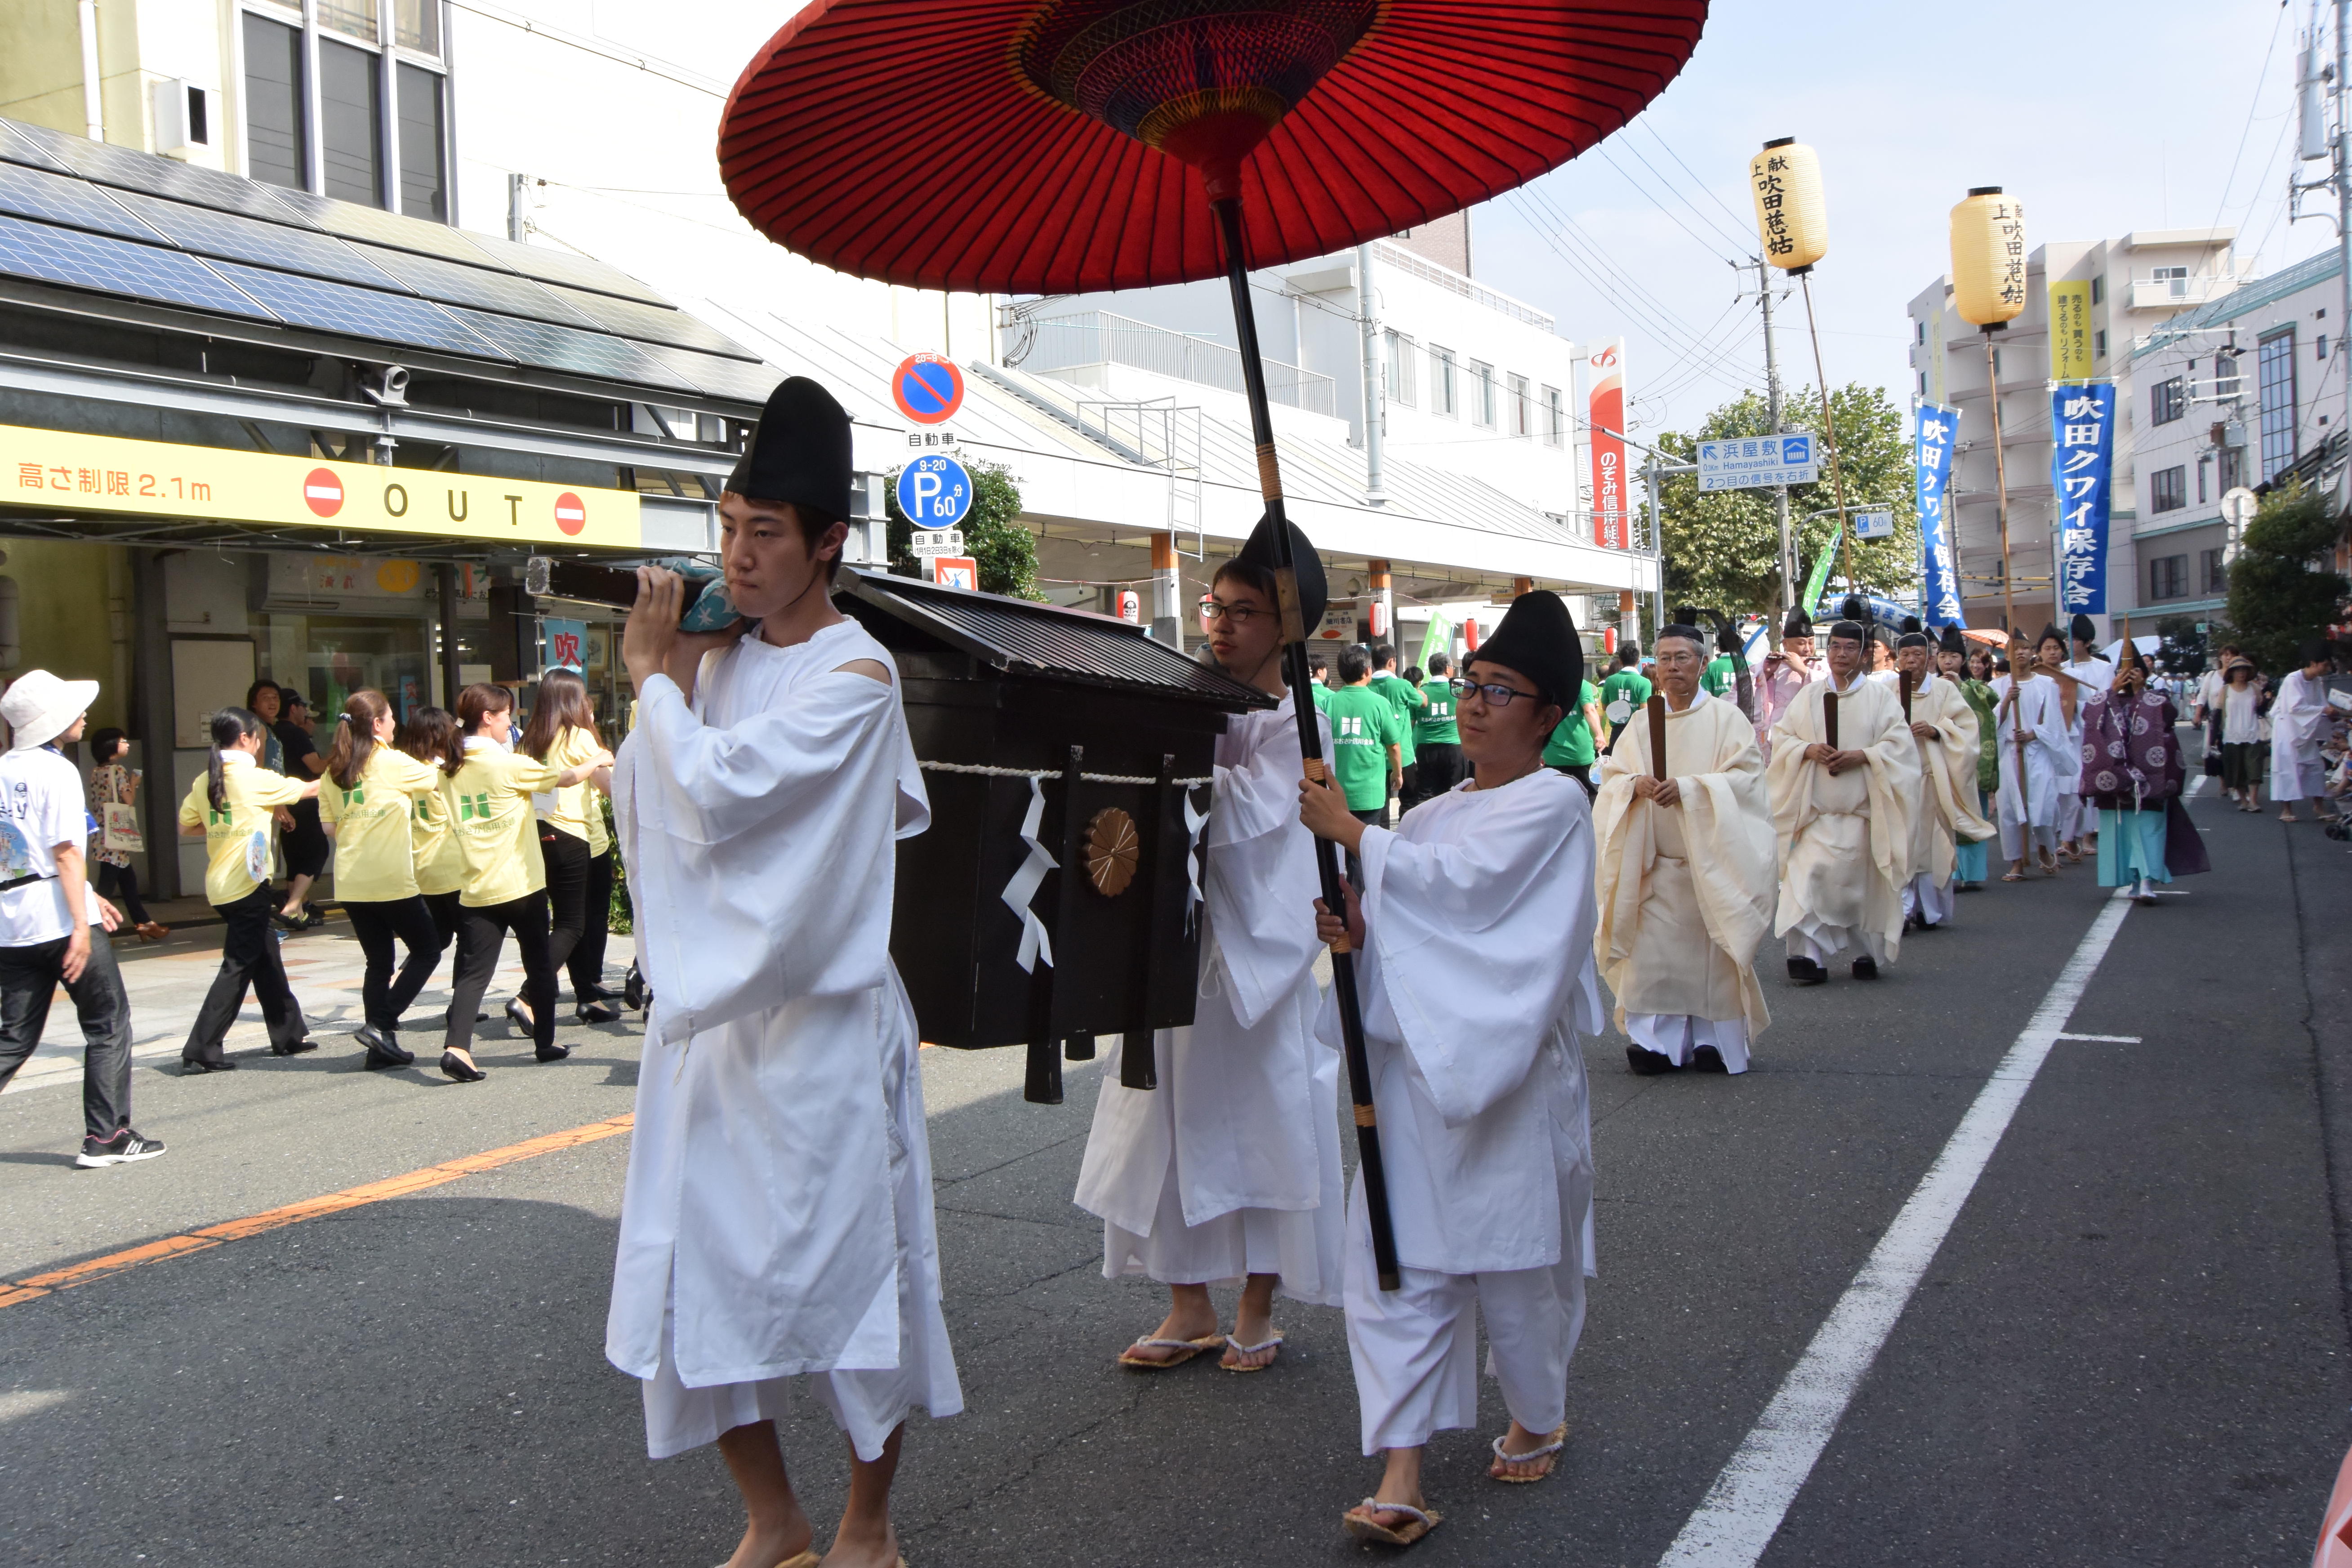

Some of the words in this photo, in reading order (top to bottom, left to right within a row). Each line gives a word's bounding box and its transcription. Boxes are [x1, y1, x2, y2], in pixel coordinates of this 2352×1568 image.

[915, 354, 938, 363] 20-9
[909, 432, 955, 447] 自動車
[1723, 440, 1778, 459] 浜屋敷
[920, 459, 947, 472] 9-20
[1723, 458, 1778, 470] Hamayashiki
[1706, 469, 1809, 489] 2つ目の信号を右折
[384, 483, 522, 526] OUT
[913, 472, 942, 518] P
[2062, 396, 2104, 605] 吹田クワイ保存会
[1921, 419, 1960, 619] 吹田クワイ保存会
[915, 533, 961, 545] 自動車
[914, 546, 962, 555] (1月1日2日3日を除く)
[553, 631, 582, 668] 吹
